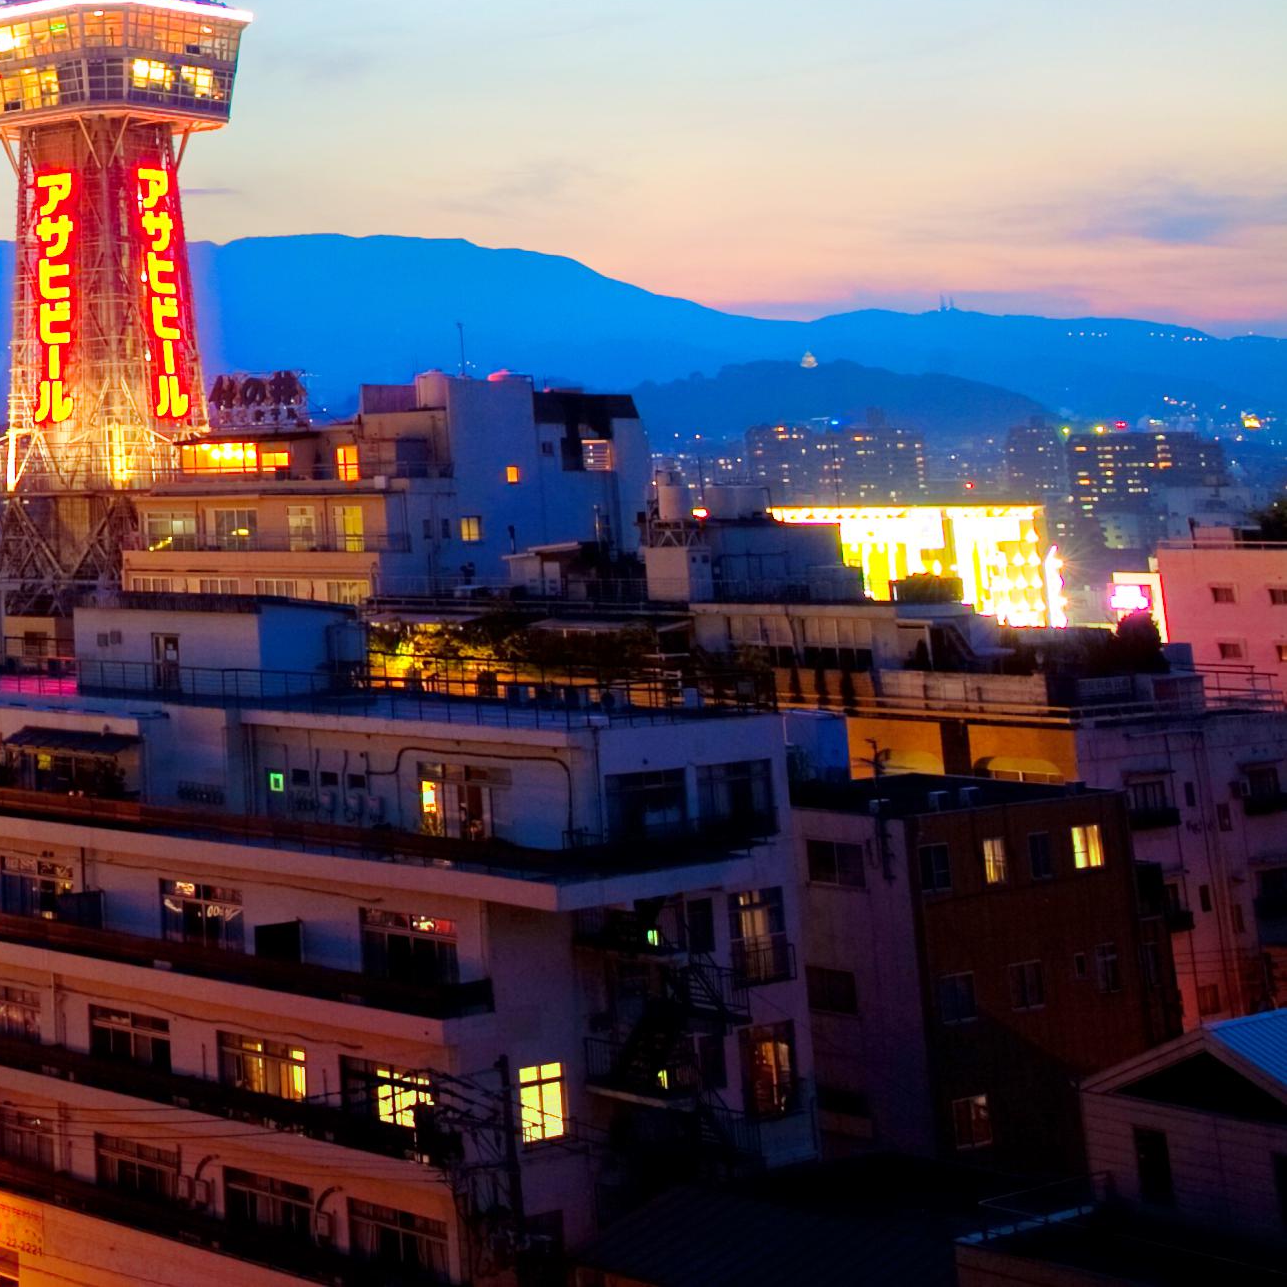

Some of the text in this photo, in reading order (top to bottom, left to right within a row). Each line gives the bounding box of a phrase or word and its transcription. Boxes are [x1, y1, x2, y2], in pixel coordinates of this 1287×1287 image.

[34, 172, 74, 423] アサヒビール
[137, 168, 189, 418] アサヒビール
